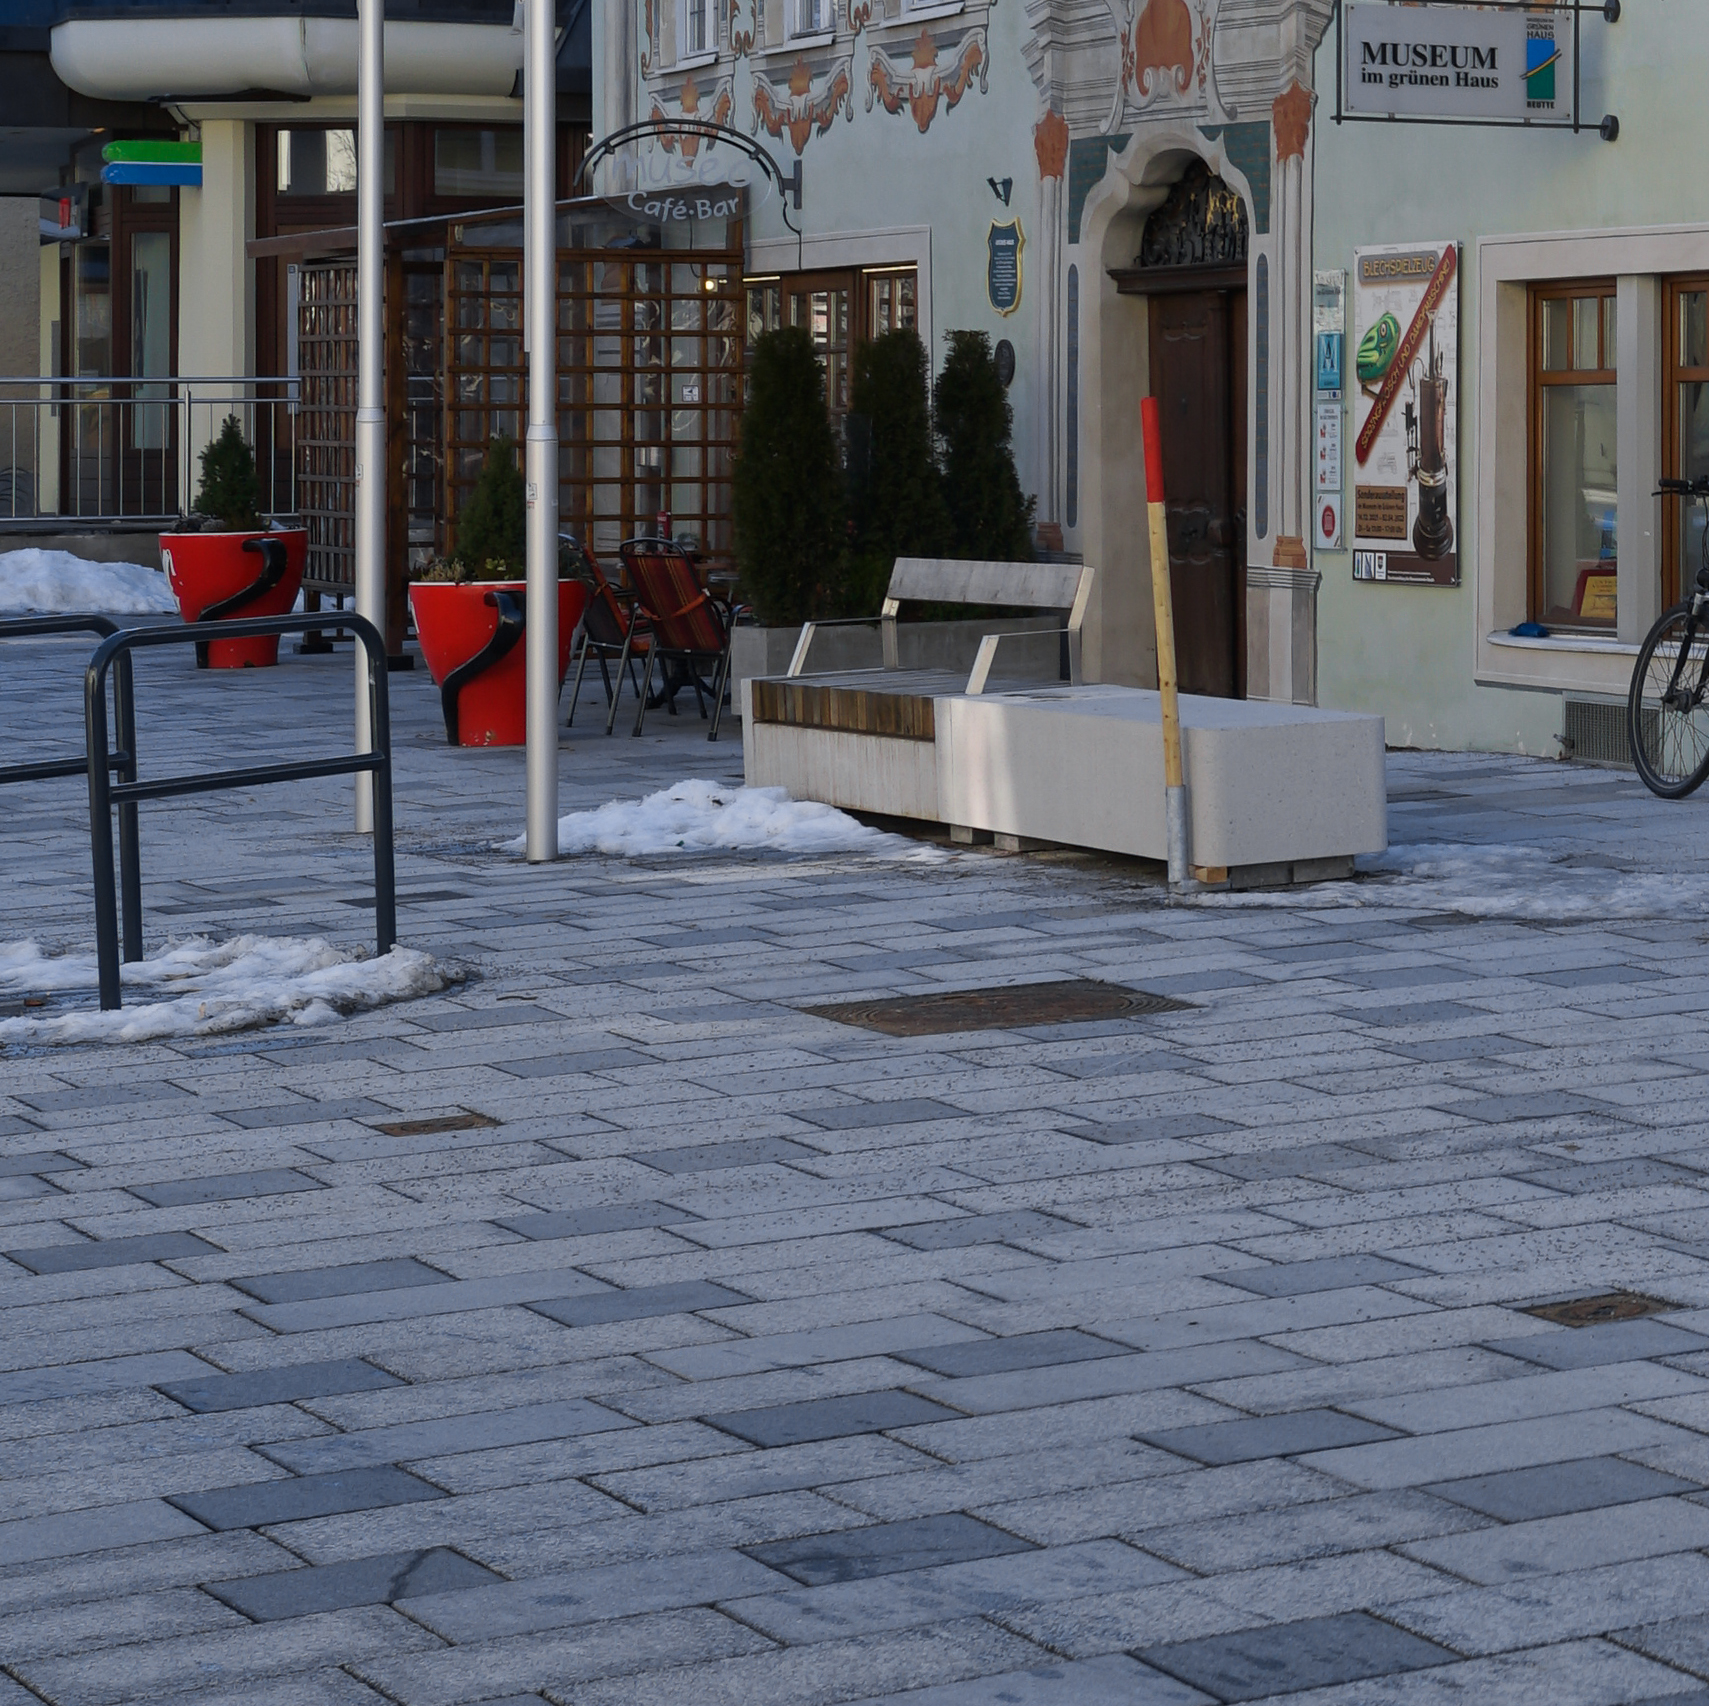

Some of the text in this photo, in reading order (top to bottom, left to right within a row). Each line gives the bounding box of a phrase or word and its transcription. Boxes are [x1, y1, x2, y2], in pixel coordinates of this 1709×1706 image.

[1527, 30, 1555, 39] HAUS
[1361, 41, 1498, 70] MUSEUM
[1361, 67, 1499, 89] im grünen Haus
[611, 151, 753, 188] museo
[1363, 256, 1435, 277] BLECHSPIELZEUG
[1398, 343, 1411, 368] UND
